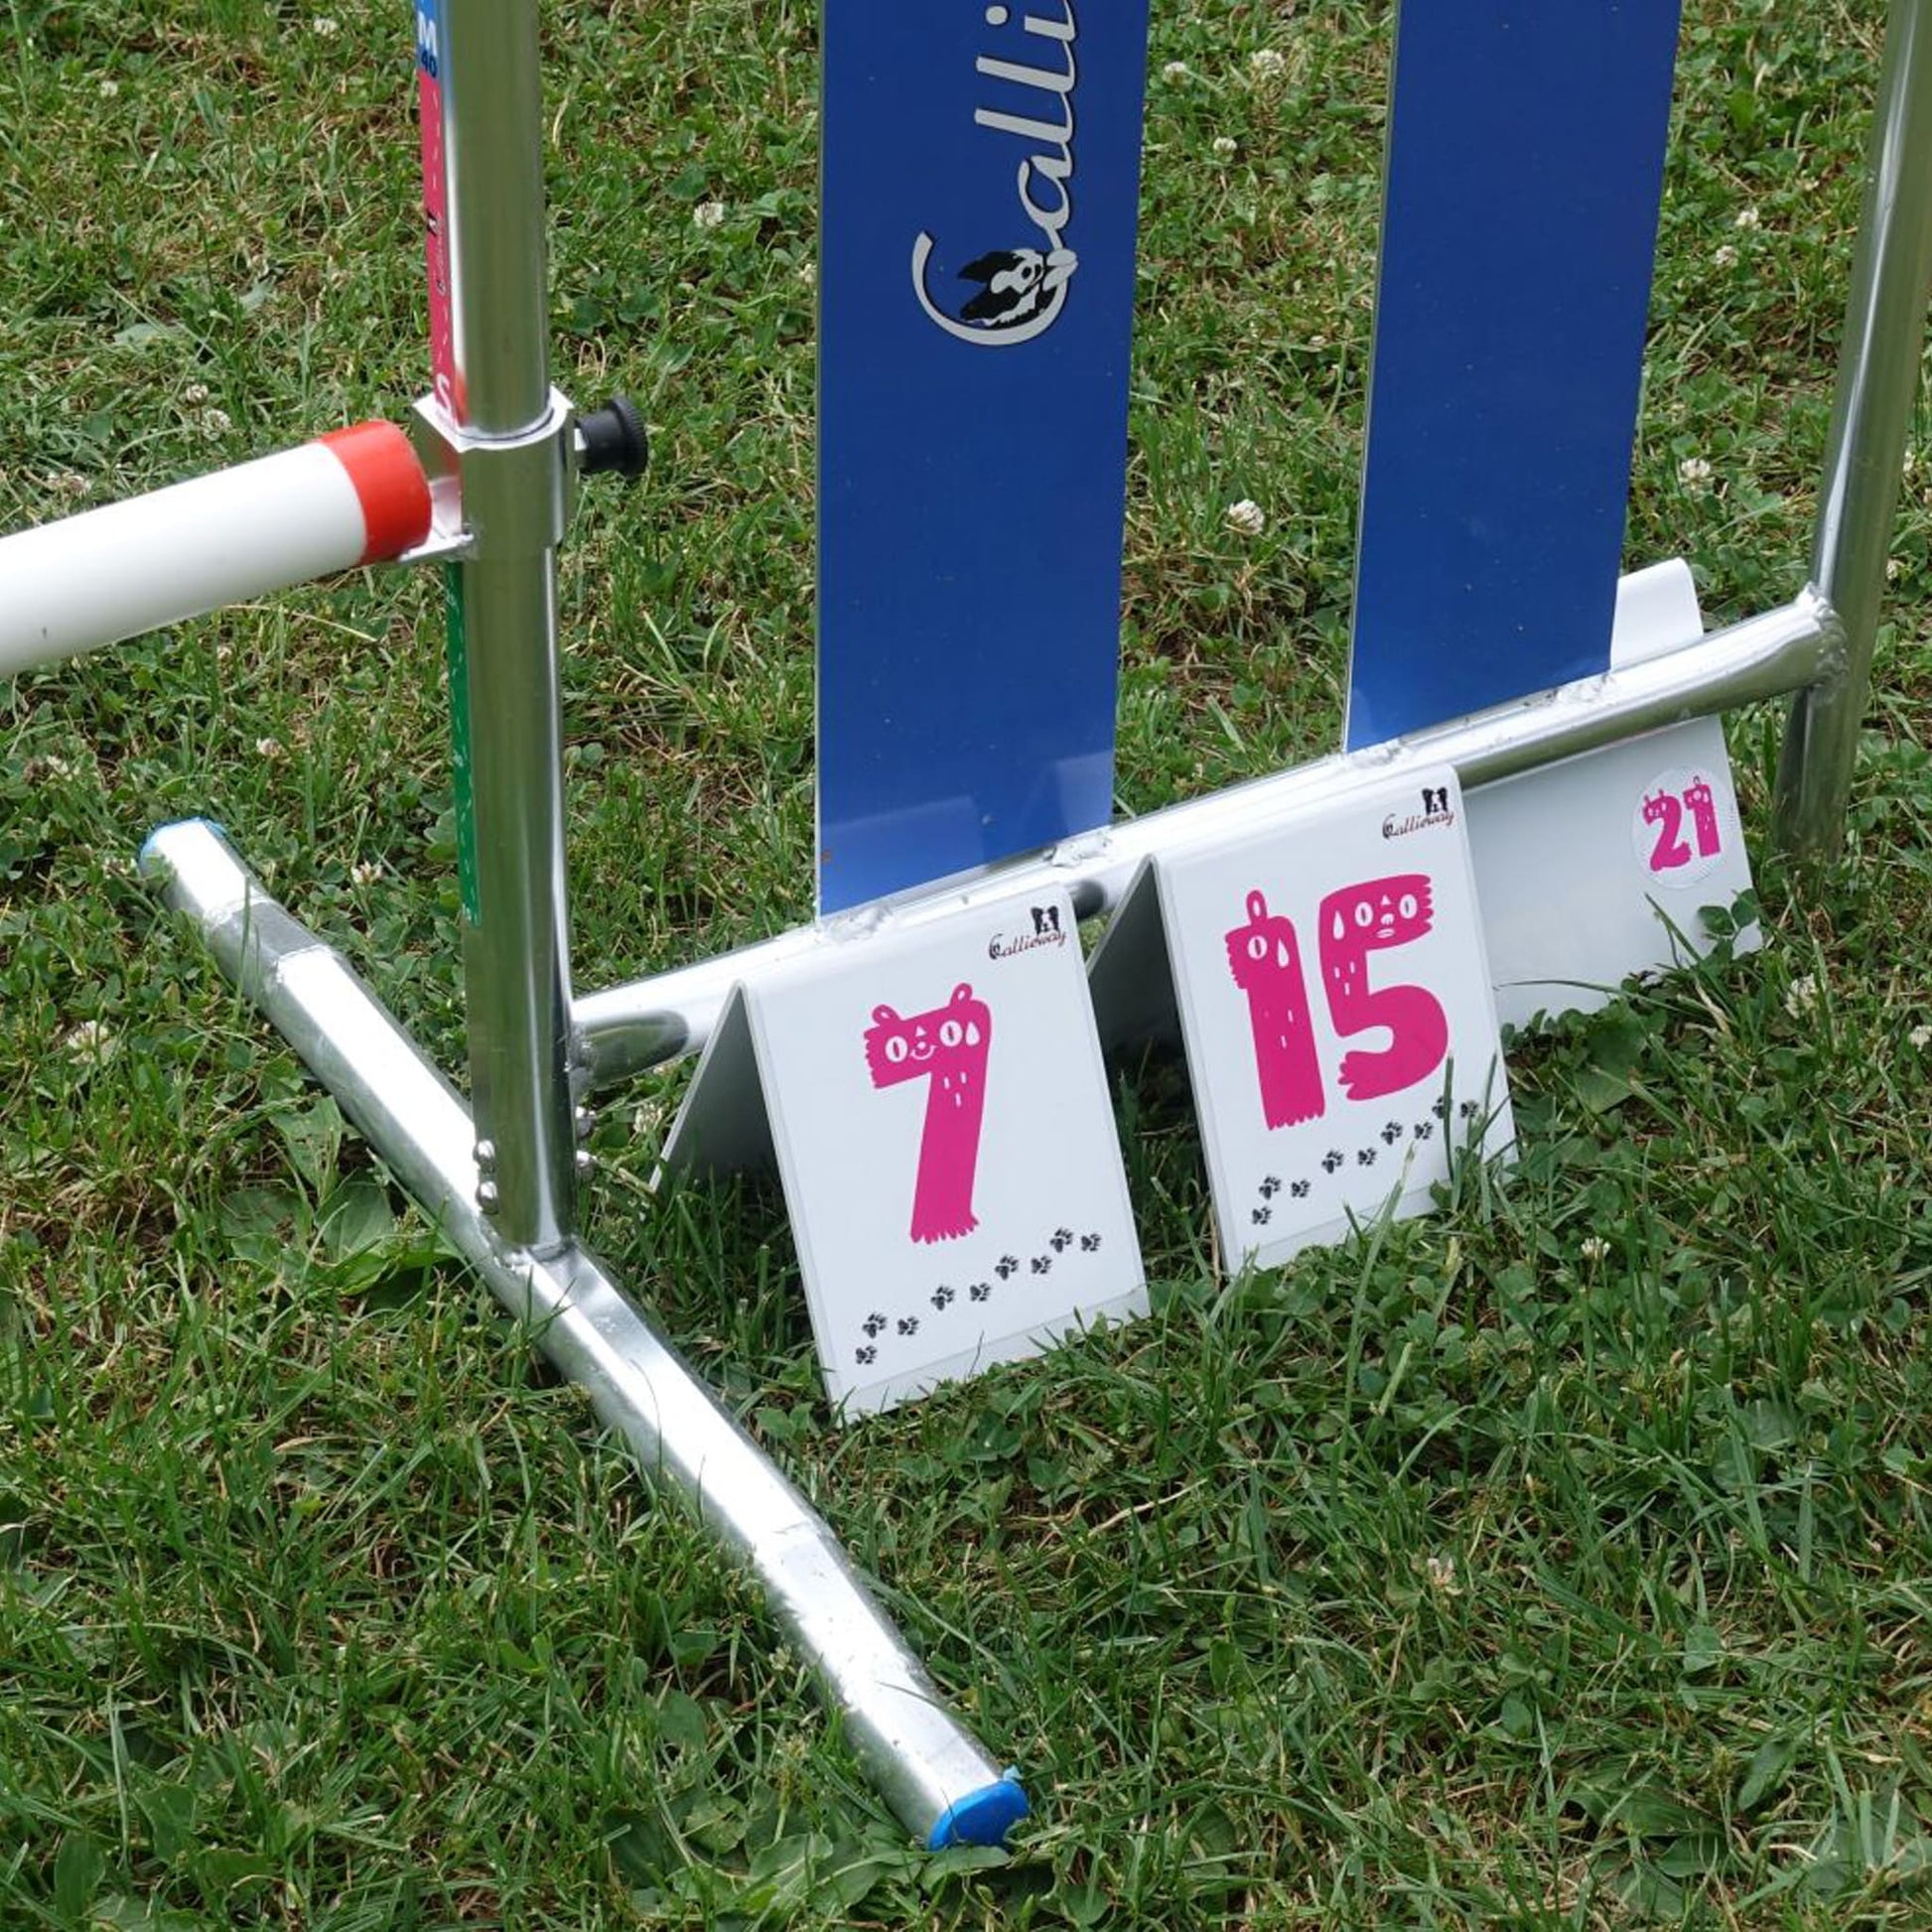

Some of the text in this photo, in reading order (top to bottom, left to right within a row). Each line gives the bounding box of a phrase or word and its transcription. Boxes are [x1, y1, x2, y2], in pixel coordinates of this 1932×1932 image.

[417, 10, 438, 58] M
[1643, 775, 1721, 872] 21
[1224, 873, 1449, 1131] 15
[863, 982, 992, 1245] 7
